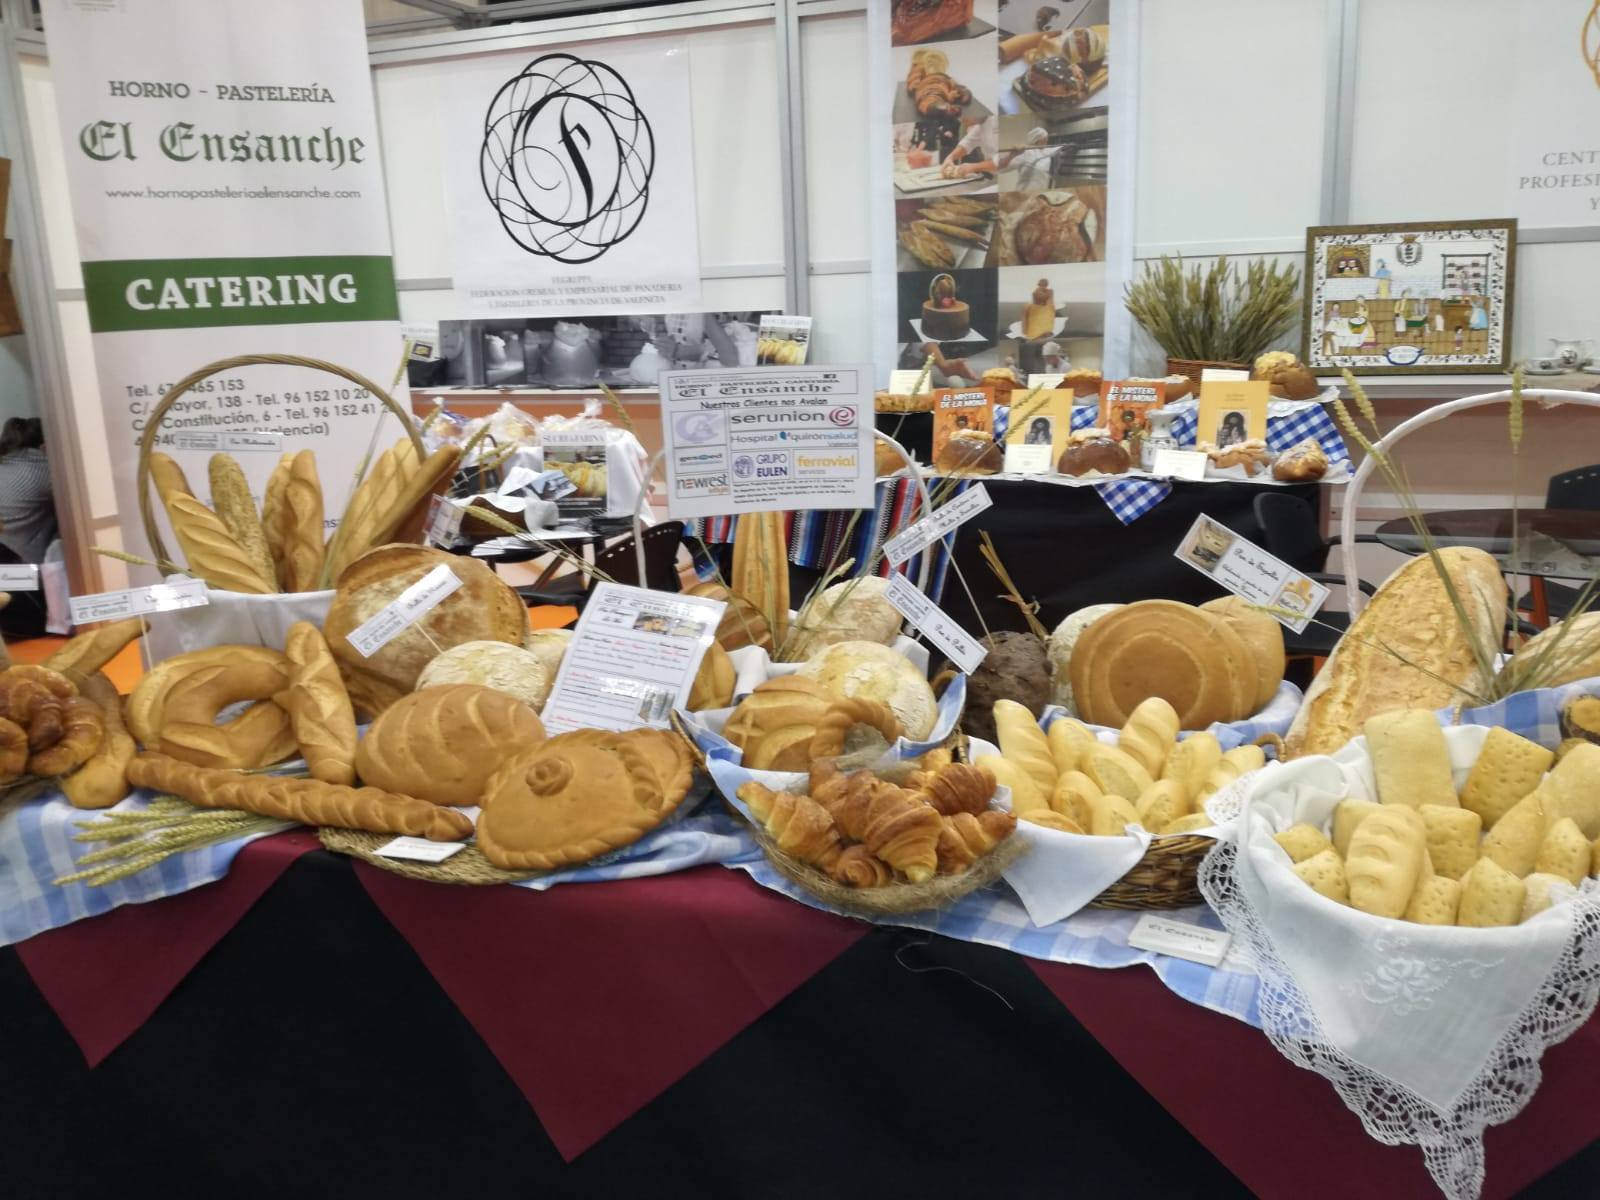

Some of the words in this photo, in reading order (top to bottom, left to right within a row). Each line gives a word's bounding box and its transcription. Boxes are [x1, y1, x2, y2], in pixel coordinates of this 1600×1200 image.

[109, 81, 190, 98] HORNO
[216, 83, 335, 103] PASTELERÍA
[79, 120, 137, 161] El
[159, 121, 366, 170] Ensanche
[105, 186, 361, 200] www.hornopasteleriaelensanche.com
[125, 273, 357, 311] CATERING
[126, 384, 153, 397] Tel.
[219, 379, 245, 391] 153
[679, 388, 706, 397] El
[719, 384, 832, 396] Ensanche
[217, 396, 242, 408] 138
[256, 393, 280, 406] Tel.
[284, 392, 302, 404] 96
[305, 390, 330, 402] 152
[334, 389, 350, 400] 10
[354, 388, 369, 399] 20
[701, 401, 741, 409] Nuestros
[743, 398, 778, 407] Clientes
[263, 411, 271, 421] 6
[285, 408, 309, 420] Tel.
[313, 407, 329, 418] 96
[334, 405, 358, 416] 152
[362, 403, 375, 414] 41
[731, 411, 825, 424] serunion
[731, 433, 778, 445] Hospital
[756, 453, 786, 465] GRUPO
[798, 455, 856, 467] ferrovial
[756, 466, 788, 478] EULEN
